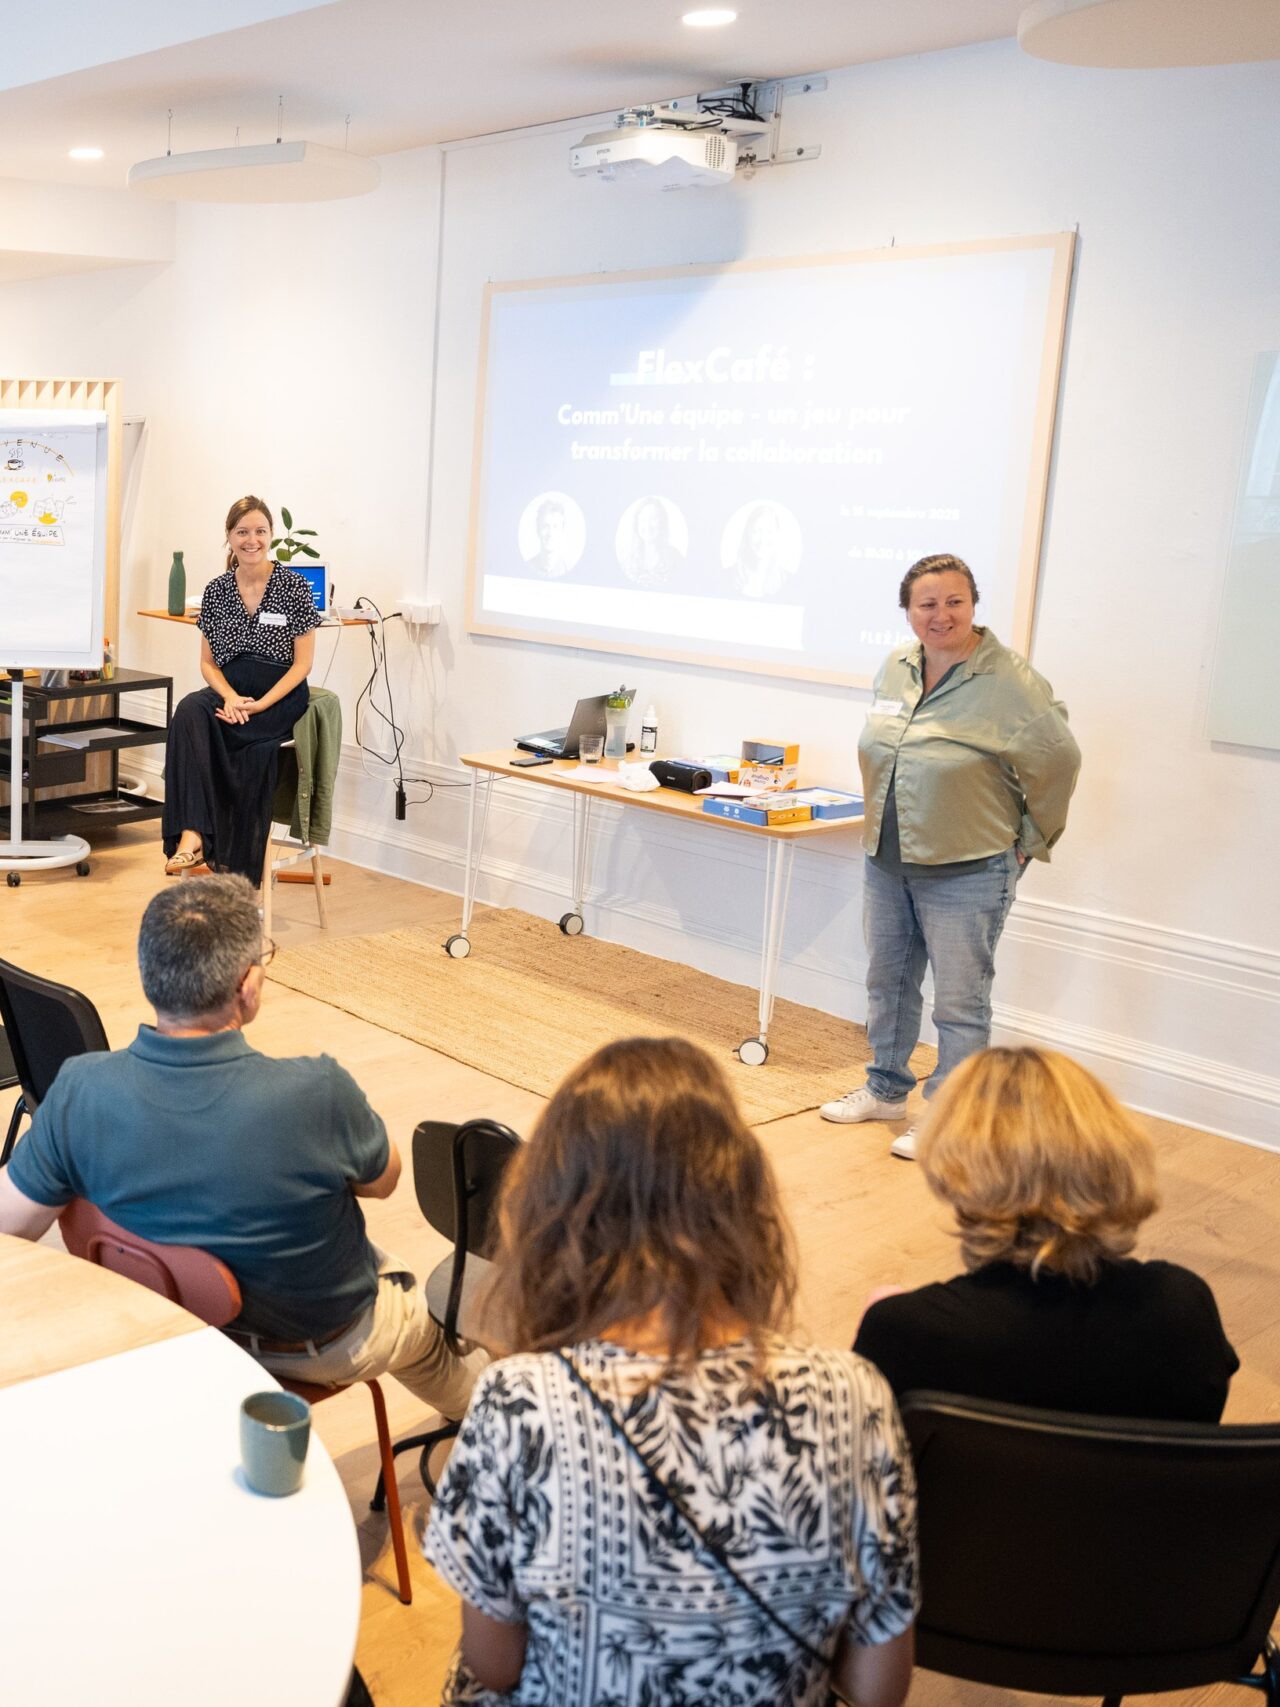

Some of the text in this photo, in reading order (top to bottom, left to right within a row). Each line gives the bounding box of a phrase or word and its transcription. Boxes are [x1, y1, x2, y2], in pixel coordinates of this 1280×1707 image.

[636, 345, 790, 384] FlexCafé
[557, 403, 665, 427] Comm'Une
[670, 402, 745, 431] équipe
[767, 407, 800, 425] un
[800, 403, 842, 431] jeu
[849, 405, 912, 431] pour
[570, 439, 883, 465] transformer la collaboration
